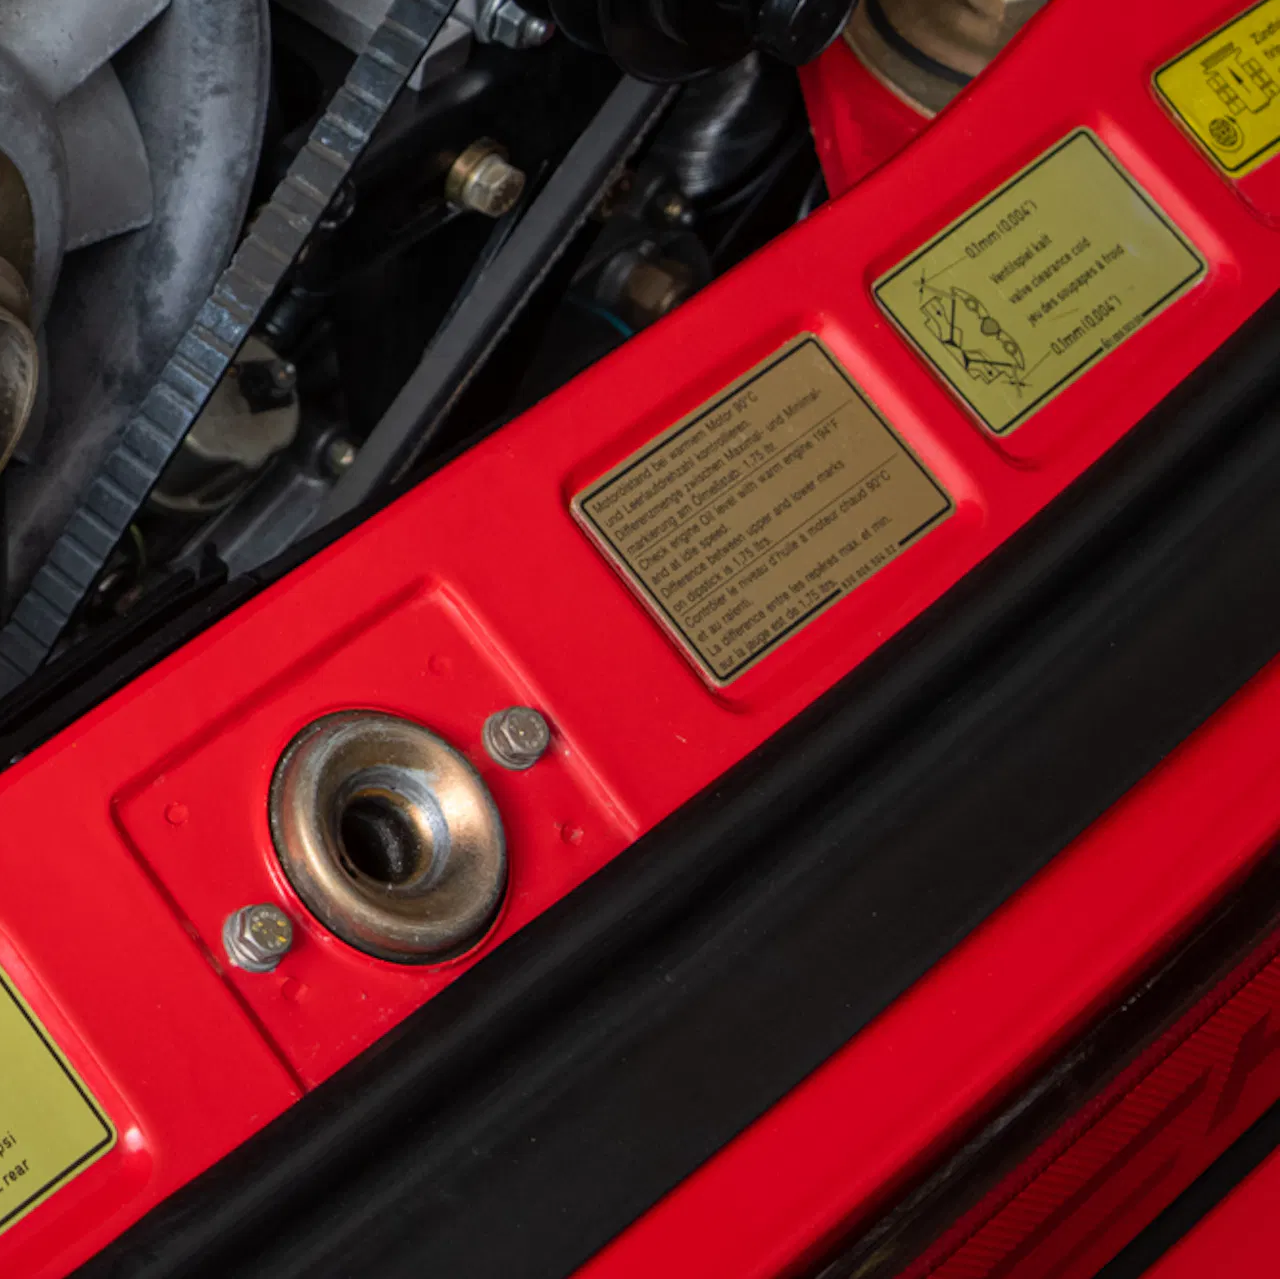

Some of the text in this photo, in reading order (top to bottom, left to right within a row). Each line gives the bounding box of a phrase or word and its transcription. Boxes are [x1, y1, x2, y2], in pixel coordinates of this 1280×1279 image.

[990, 234, 1053, 285] Ventilspiel kalt
[1009, 237, 1091, 304] valve clearance cold
[1028, 312, 1043, 327] jeu
[1040, 297, 1059, 314] des
[1056, 267, 1098, 302] soupapes
[1100, 243, 1125, 265] froid
[591, 467, 653, 514] Motorölstand
[650, 458, 669, 472] bei
[669, 429, 707, 461] warmem
[704, 409, 733, 432] Motor
[605, 509, 625, 529] und
[622, 456, 695, 515] Leerlaufdrehzahl
[613, 489, 684, 543] Differenzmenge
[683, 458, 726, 493] zwischen
[765, 413, 785, 433] und
[626, 515, 679, 555] markierung
[676, 503, 693, 520] am
[638, 547, 670, 572] Check
[669, 523, 701, 550] engine
[713, 495, 737, 515] level
[736, 481, 758, 499] with
[757, 462, 784, 484] warm
[782, 440, 814, 465] engine
[659, 459, 845, 600] Difference between upper and lower marks
[651, 566, 671, 586] and
[669, 558, 682, 572] at
[681, 546, 700, 563] idle
[725, 585, 739, 596] le
[737, 563, 769, 589] niveau
[807, 509, 839, 537] moteur
[839, 488, 868, 514] chaud
[672, 599, 688, 613] on
[686, 572, 723, 603] dipstick
[723, 564, 734, 576] is
[705, 643, 723, 657] La
[765, 591, 791, 613] entre
[787, 579, 806, 594] les
[860, 528, 873, 541] et
[697, 629, 709, 643] et
[708, 621, 723, 635] au
[718, 655, 740, 675] sur
[732, 648, 750, 663] la
[745, 628, 771, 655] jauge
[770, 615, 788, 636] est
[785, 606, 801, 620] de
[2, 1159, 30, 1186] rear
